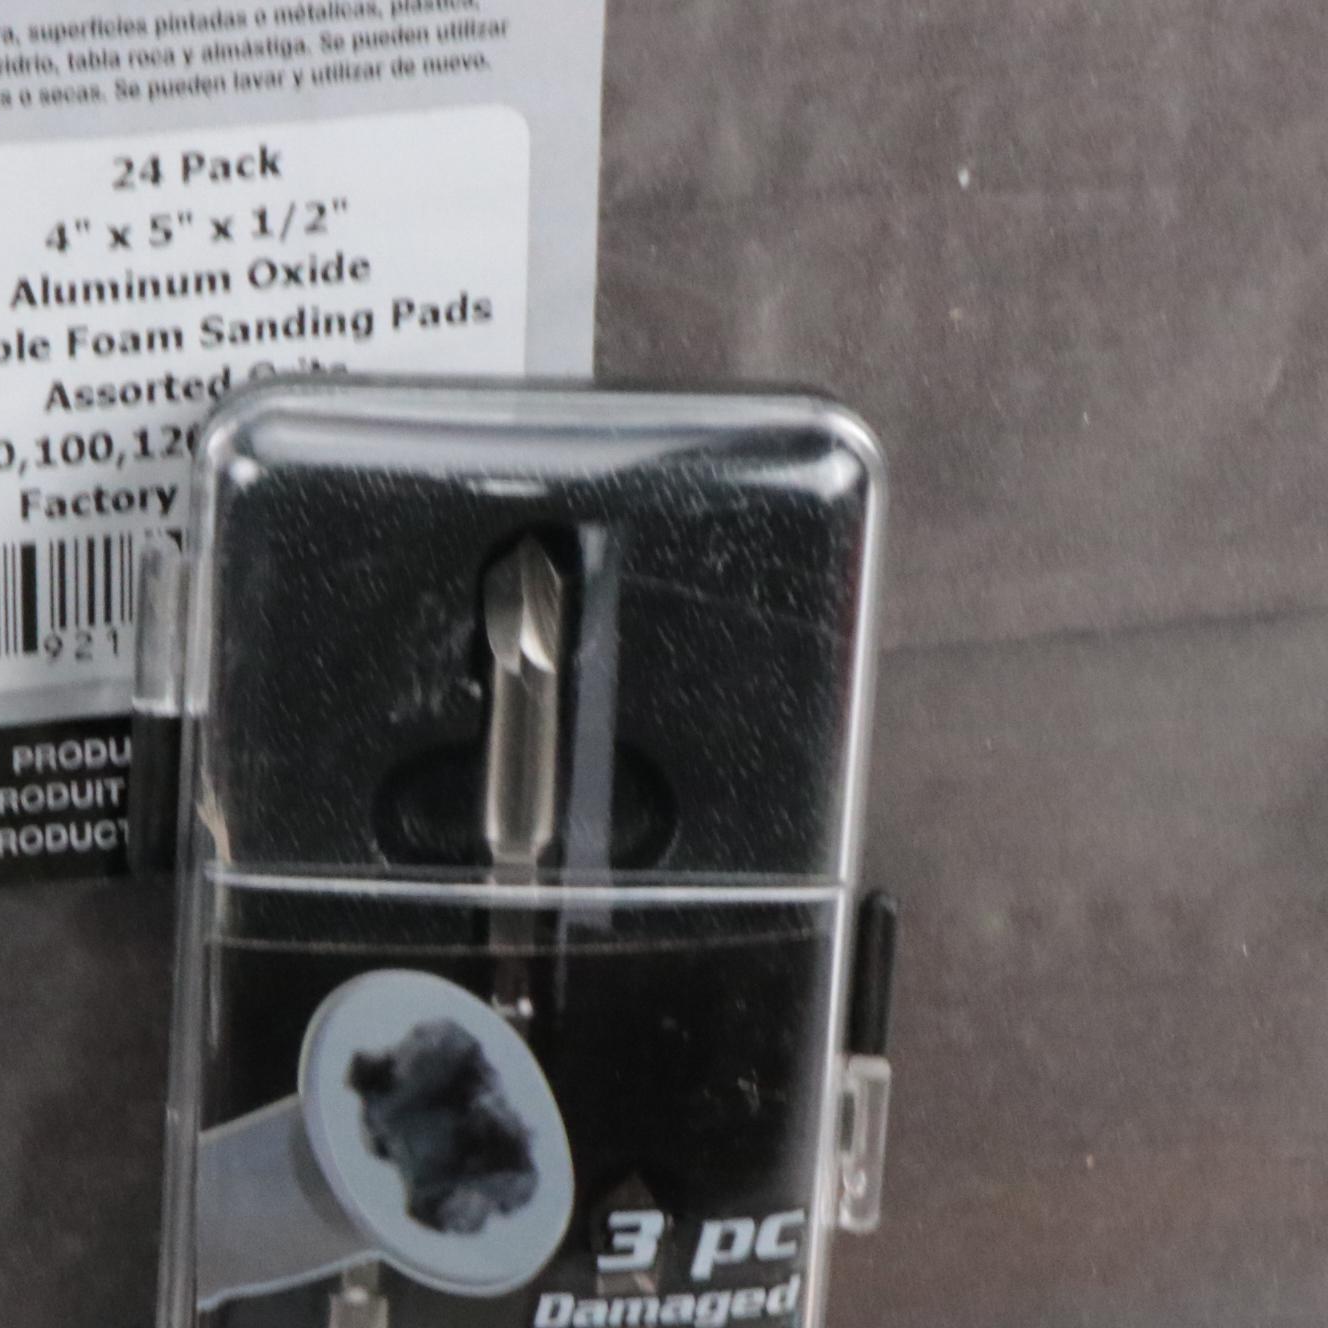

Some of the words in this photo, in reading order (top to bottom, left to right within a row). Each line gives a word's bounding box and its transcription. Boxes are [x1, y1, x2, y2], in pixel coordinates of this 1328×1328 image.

[28, 15, 147, 46] superficies
[155, 8, 246, 39] pintadas
[67, 48, 121, 73] tabla
[128, 48, 175, 70] roca
[182, 46, 194, 68] y
[320, 30, 345, 53] Se
[352, 24, 429, 53] pueden
[436, 18, 508, 44] utilizar
[115, 78, 140, 101] Se
[147, 72, 225, 101] pueden
[233, 68, 284, 92] lavar
[292, 69, 303, 92] y
[311, 61, 382, 86] utilizar
[391, 55, 415, 78] de
[112, 154, 162, 191] 24
[182, 144, 281, 185] Pack
[45, 217, 90, 253] 4"
[108, 223, 131, 249] x
[148, 210, 193, 248] 5"
[211, 216, 232, 242] x
[251, 197, 348, 242] 1/2"
[9, 270, 231, 309] Aluminum
[246, 250, 372, 288] Oxide
[67, 321, 184, 361] Foam
[200, 305, 375, 349] Sanding
[391, 290, 493, 330] Pads
[44, 366, 232, 413] Assorted
[20, 483, 178, 522] Factory
[596, 1208, 664, 1273] 3
[690, 1208, 805, 1282] pc
